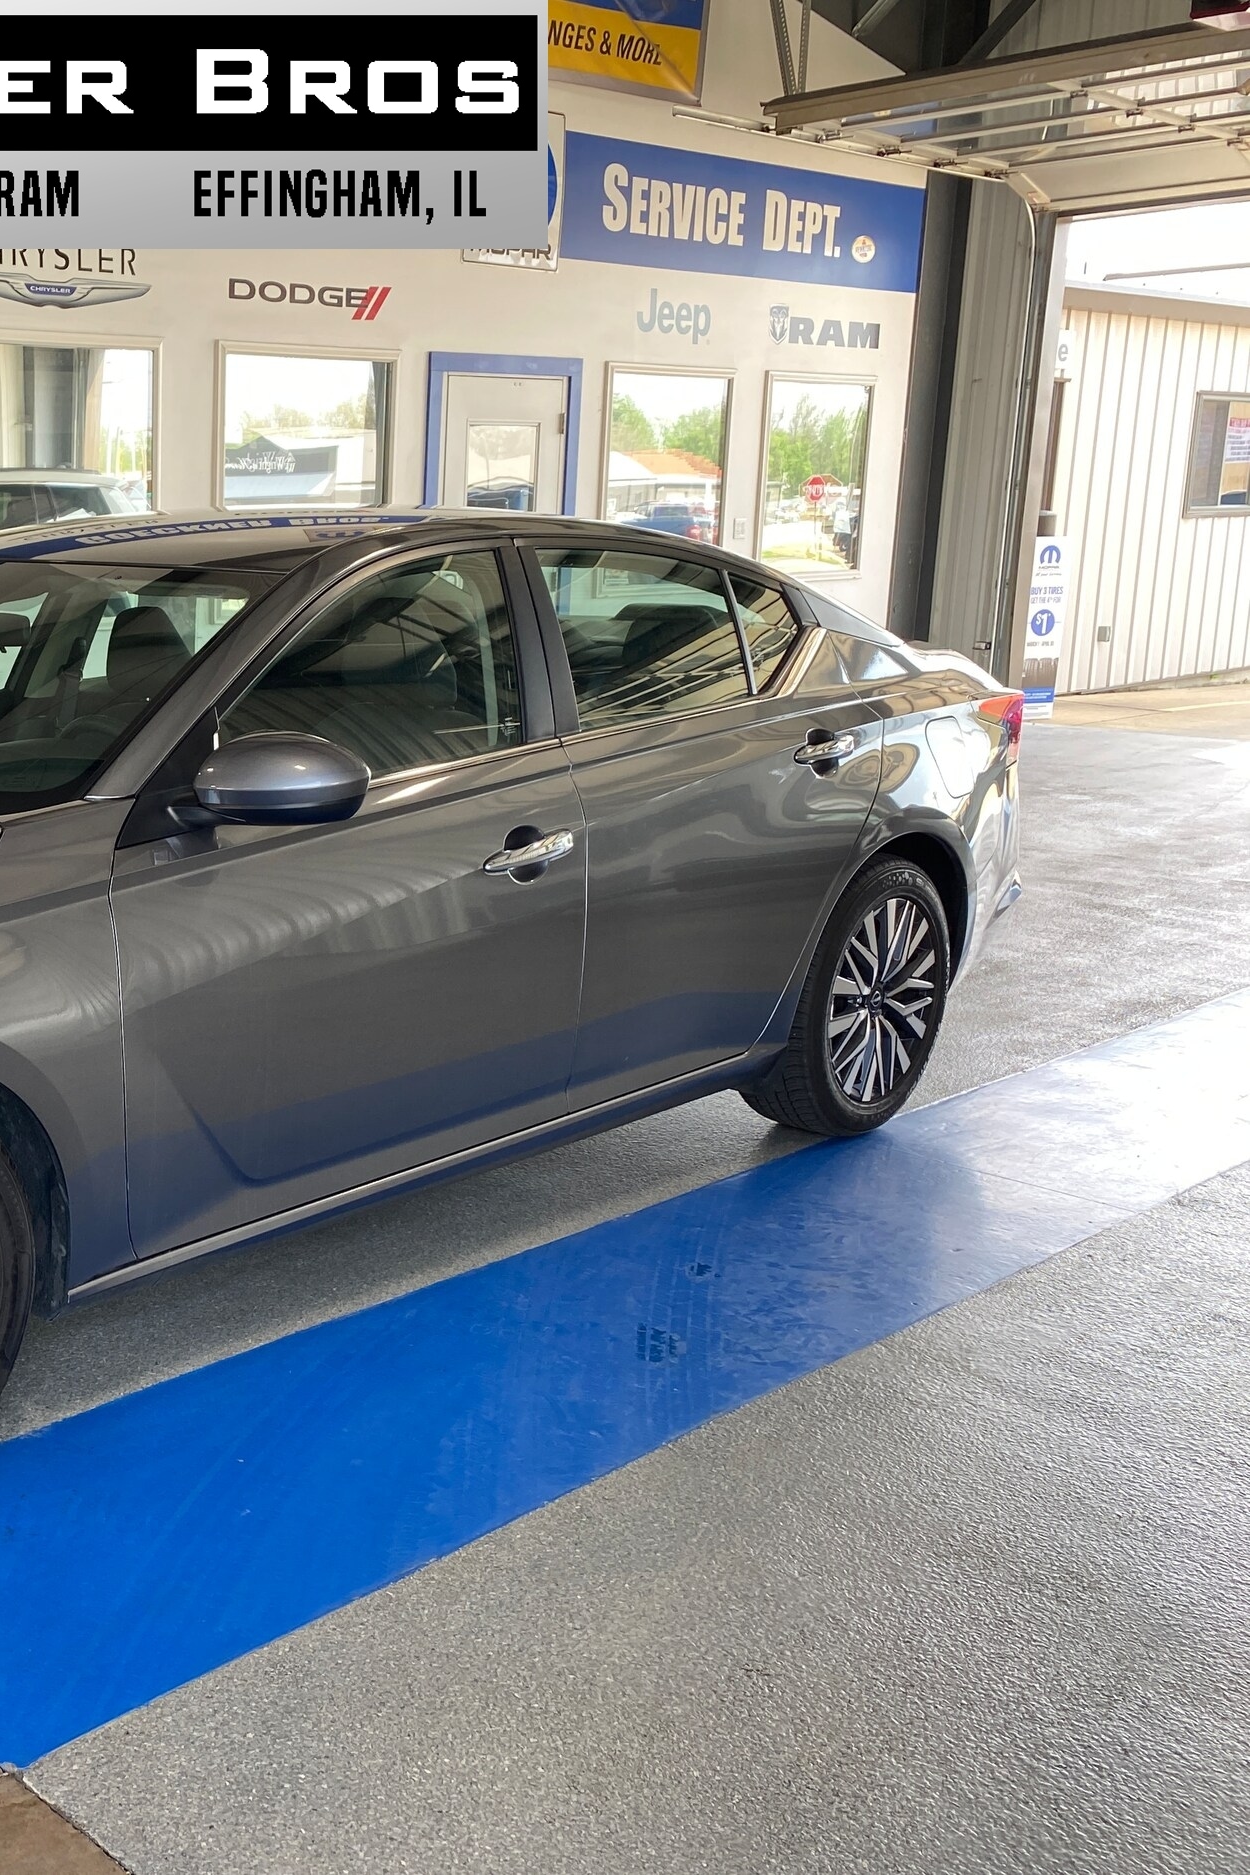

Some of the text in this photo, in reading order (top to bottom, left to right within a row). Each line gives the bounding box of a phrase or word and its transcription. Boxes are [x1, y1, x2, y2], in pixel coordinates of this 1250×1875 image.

[599, 30, 612, 55] &
[602, 162, 841, 258] SERVICE DEPT.
[29, 285, 71, 294] CHRYSLER
[228, 277, 369, 308] DODGE
[636, 288, 711, 345] Jeep
[787, 316, 881, 349] RAM
